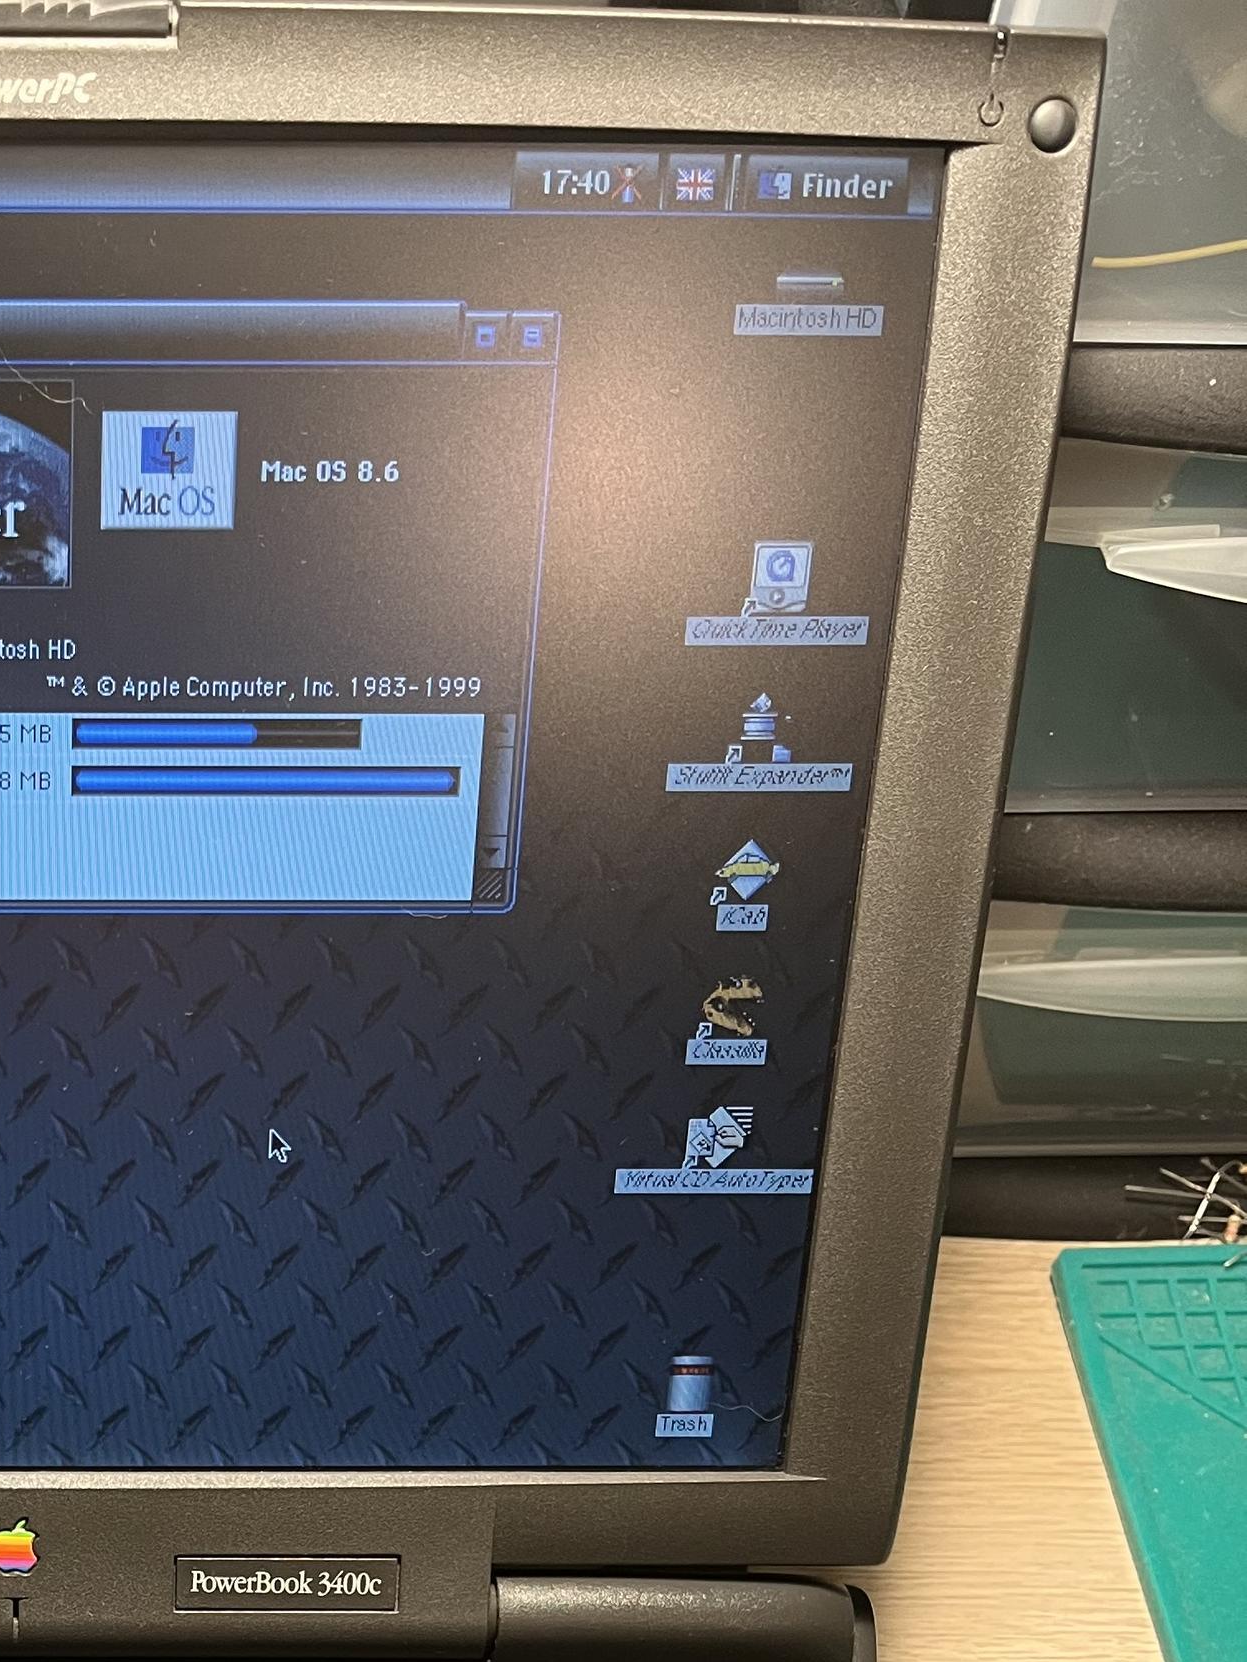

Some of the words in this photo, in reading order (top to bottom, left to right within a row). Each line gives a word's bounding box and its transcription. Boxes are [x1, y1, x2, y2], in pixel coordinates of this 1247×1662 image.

[543, 170, 610, 196] 17:40
[802, 173, 893, 199] Finder
[738, 307, 840, 328] Macintosh
[846, 308, 876, 328] HD
[260, 459, 306, 483] Mac
[317, 459, 346, 483] OS
[358, 459, 399, 483] 8.6
[118, 488, 171, 516] Mac
[178, 488, 216, 516] OS
[801, 619, 866, 642] Player
[48, 639, 76, 660] HD
[71, 677, 88, 697] &
[97, 677, 116, 697] ©
[123, 677, 180, 701] Apple
[186, 677, 295, 701] Computer,
[303, 677, 340, 697] Inc.
[350, 677, 482, 697] 1983-1999
[20, 723, 52, 744] MB
[20, 770, 51, 790] MB
[721, 905, 766, 925] iCab
[661, 1416, 707, 1431] Trash
[190, 1571, 313, 1595] PowerBook
[318, 1571, 382, 1597] 3400c
